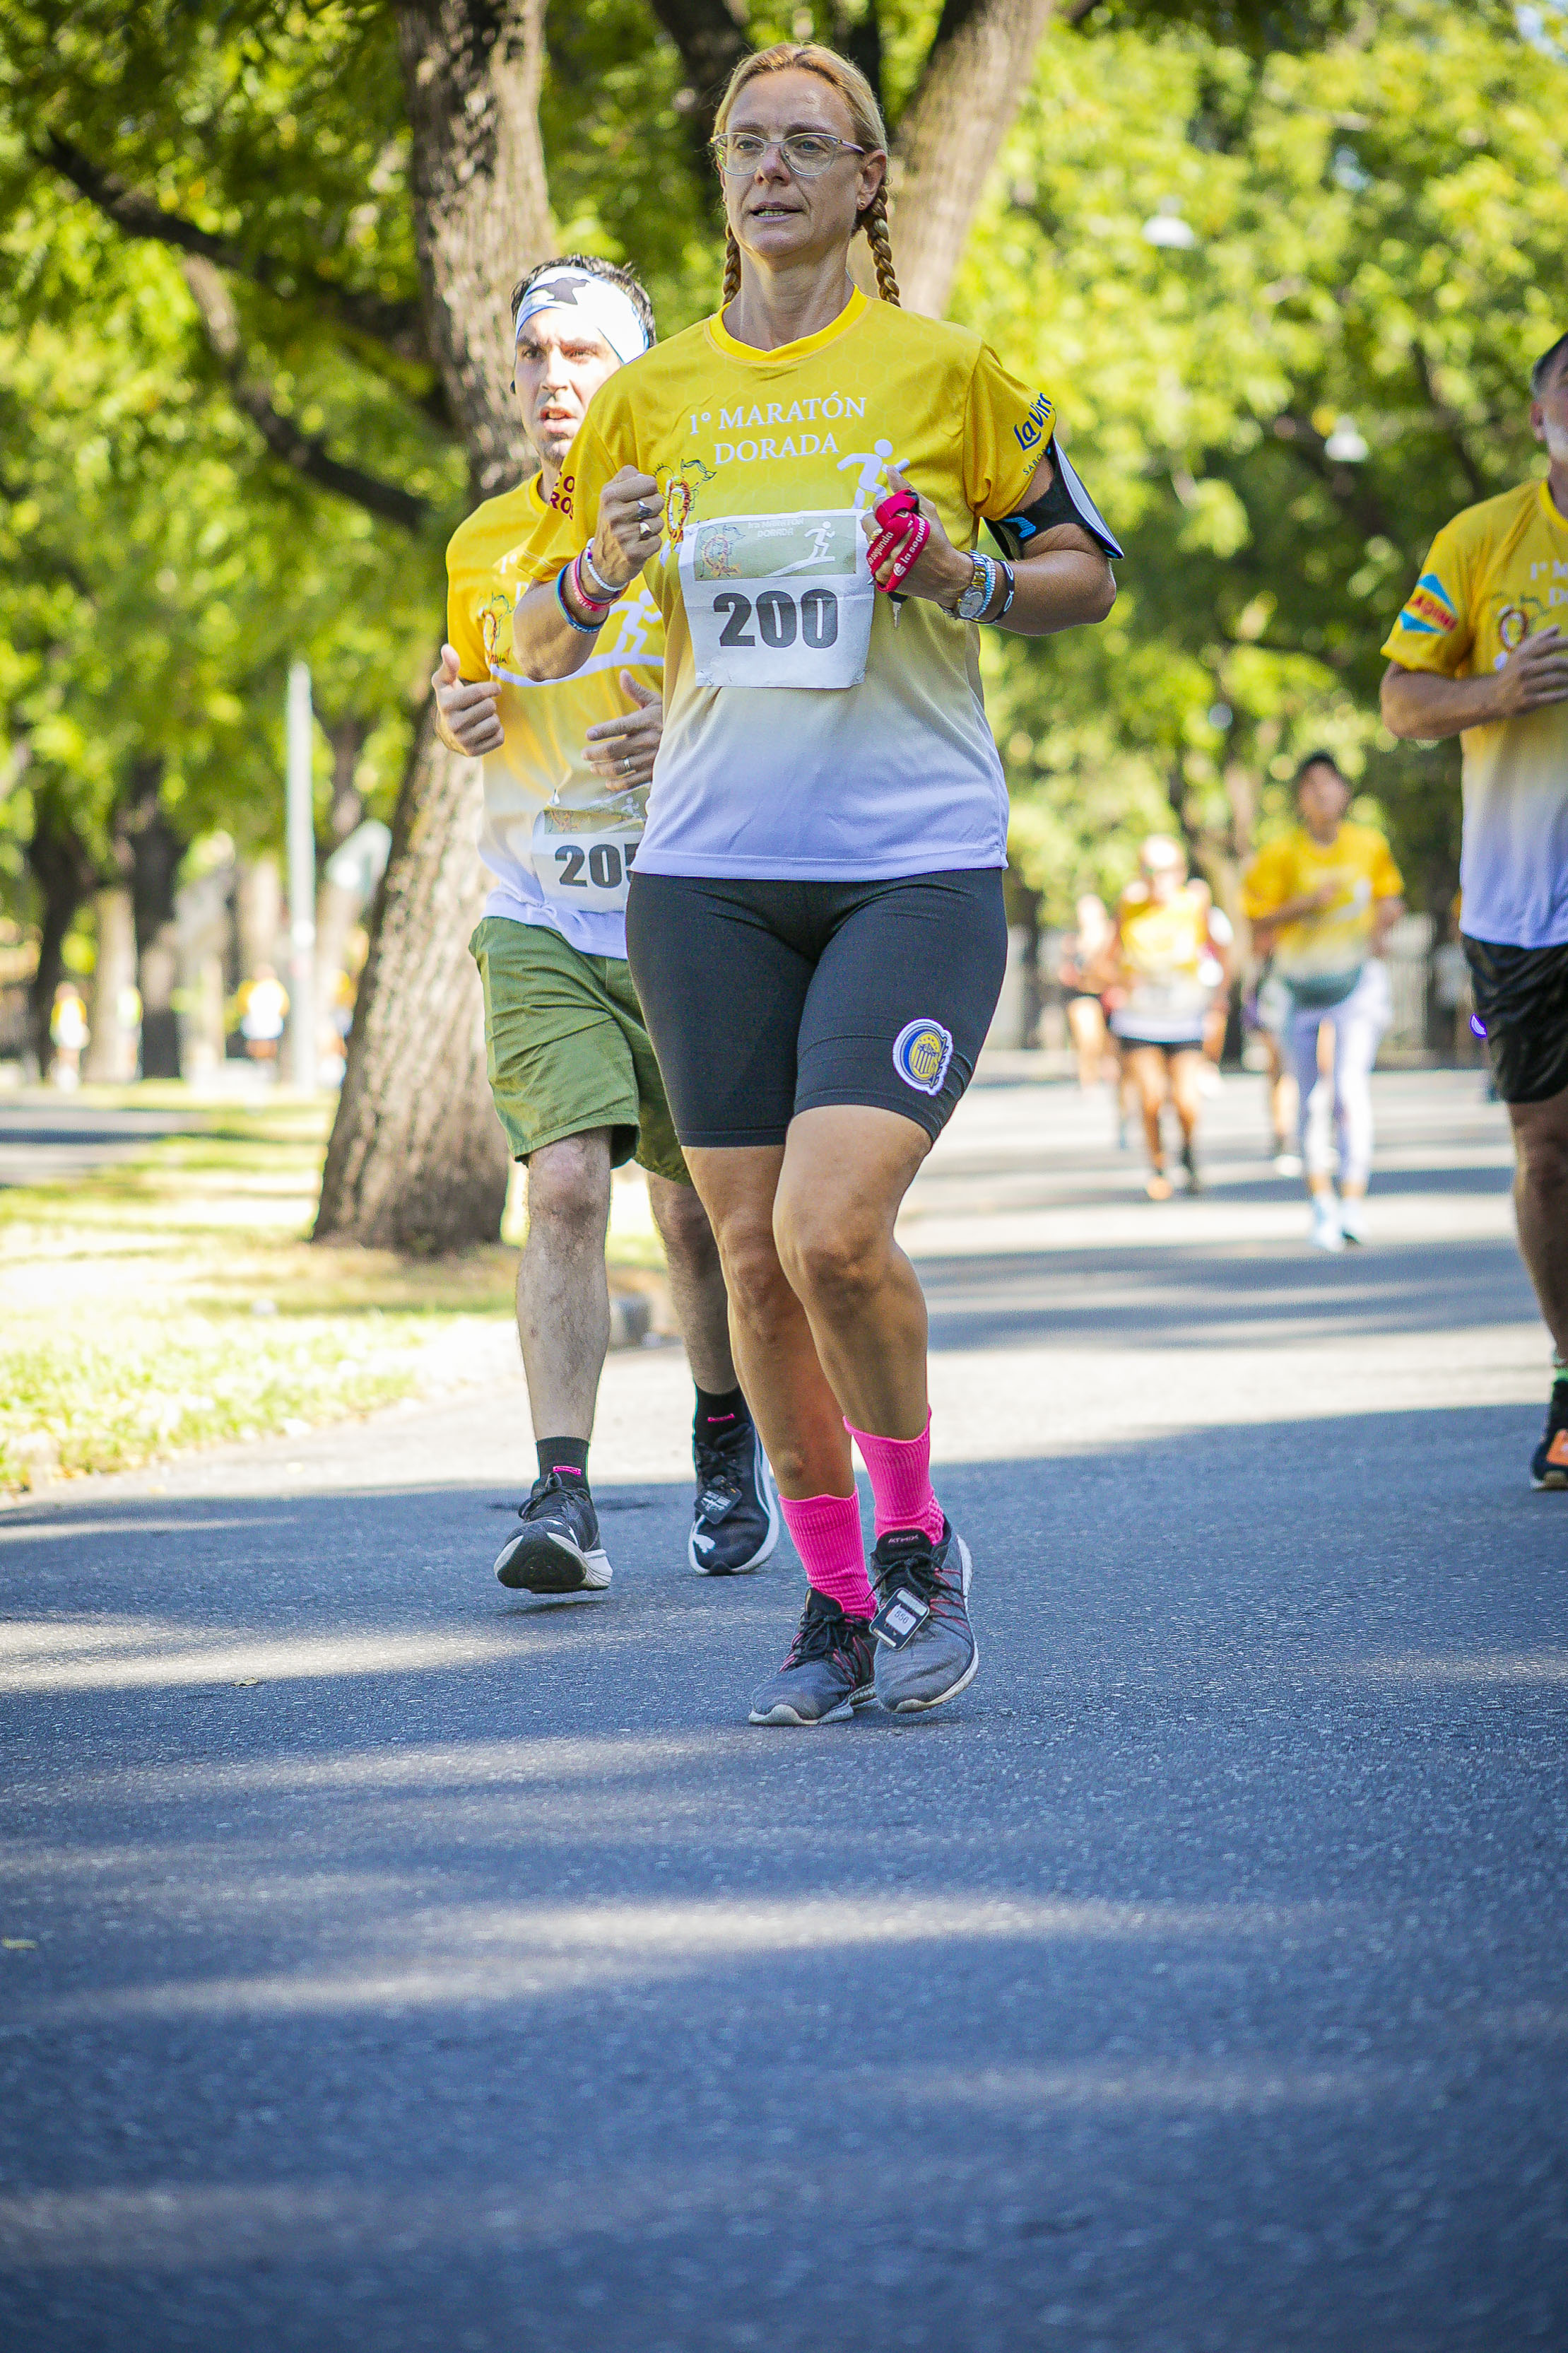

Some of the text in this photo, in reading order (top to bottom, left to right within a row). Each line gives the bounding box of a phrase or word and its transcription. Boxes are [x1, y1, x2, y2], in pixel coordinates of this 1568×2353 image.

[719, 391, 867, 430] MARATÓN
[714, 433, 839, 465] DORADA
[900, 553, 912, 564] la
[714, 589, 838, 648] 200
